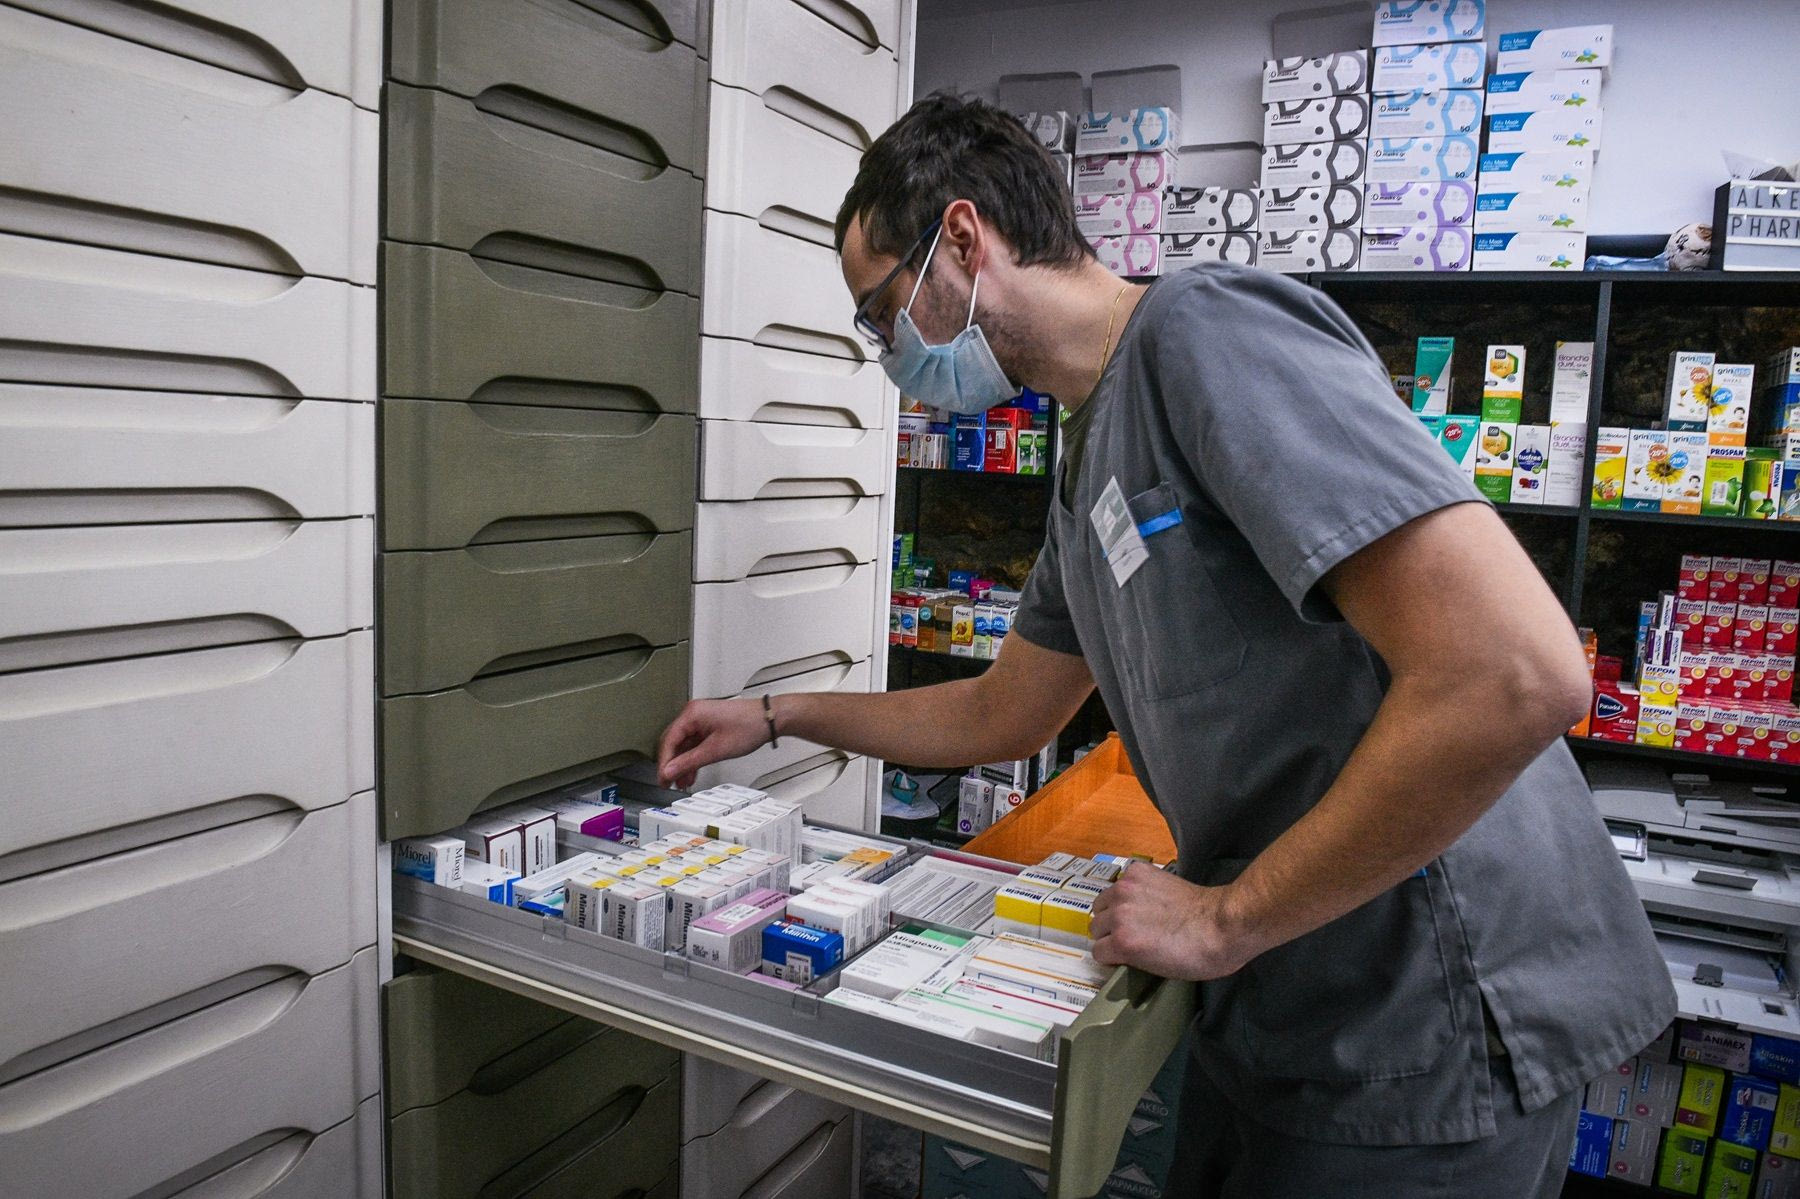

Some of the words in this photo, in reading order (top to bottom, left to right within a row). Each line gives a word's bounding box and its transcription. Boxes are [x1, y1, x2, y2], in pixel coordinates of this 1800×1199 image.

[399, 843, 431, 864] Miorel
[453, 847, 463, 881] Miorel
[1026, 872, 1061, 884] Minocin
[1005, 888, 1042, 901] Minocin
[1071, 882, 1102, 893] inocin
[579, 893, 588, 928] Minitra
[1052, 897, 1090, 910] Minocin
[617, 904, 626, 940] Minitra
[1704, 1035, 1746, 1051] ANIMEX
